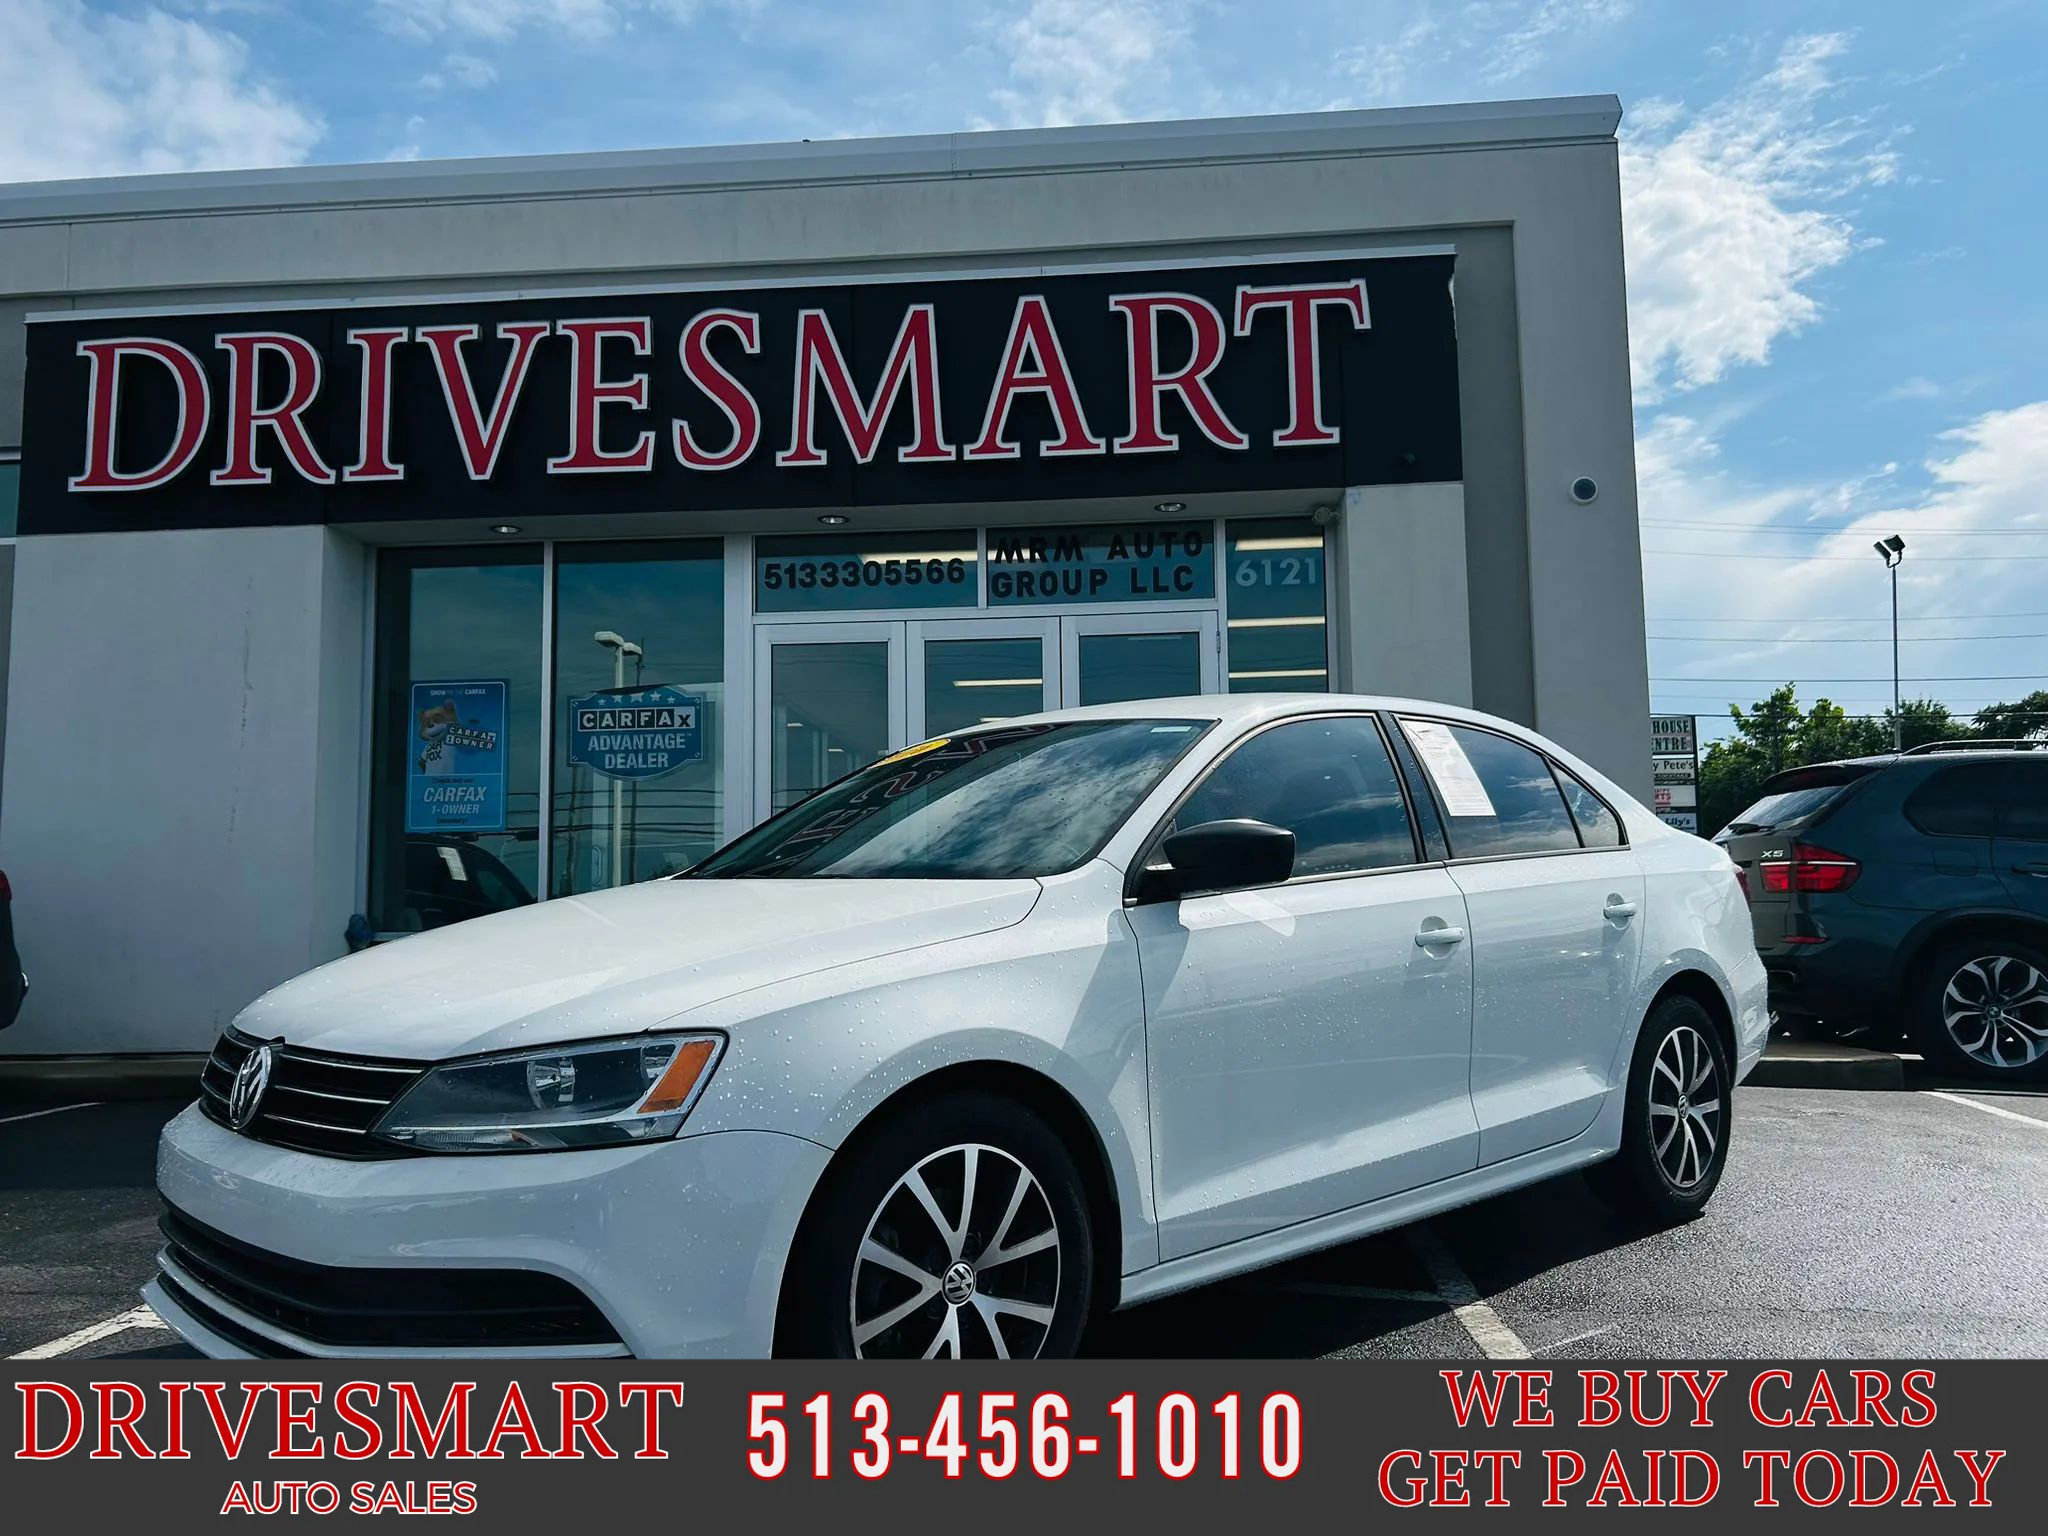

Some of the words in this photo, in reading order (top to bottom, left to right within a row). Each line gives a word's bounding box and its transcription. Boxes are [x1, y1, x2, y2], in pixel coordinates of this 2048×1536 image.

[67, 277, 1372, 493] DRIVESMART
[994, 535, 1084, 563] MRM
[1107, 531, 1203, 561] AUTO
[764, 557, 965, 589] 5133305566
[1235, 556, 1318, 587] 6121
[991, 565, 1109, 598] GROUP
[1130, 565, 1194, 594] LLC
[580, 709, 694, 731] CARFAX
[1652, 720, 1690, 734] HOUSE
[448, 725, 497, 742] CARFAX
[588, 733, 686, 751] ADVANTAGE
[604, 753, 669, 769] DEALER
[1664, 760, 1694, 770] Pete's
[424, 786, 488, 803] CARFAX
[431, 804, 480, 815] 1-OWNER
[1761, 848, 1785, 858] X5
